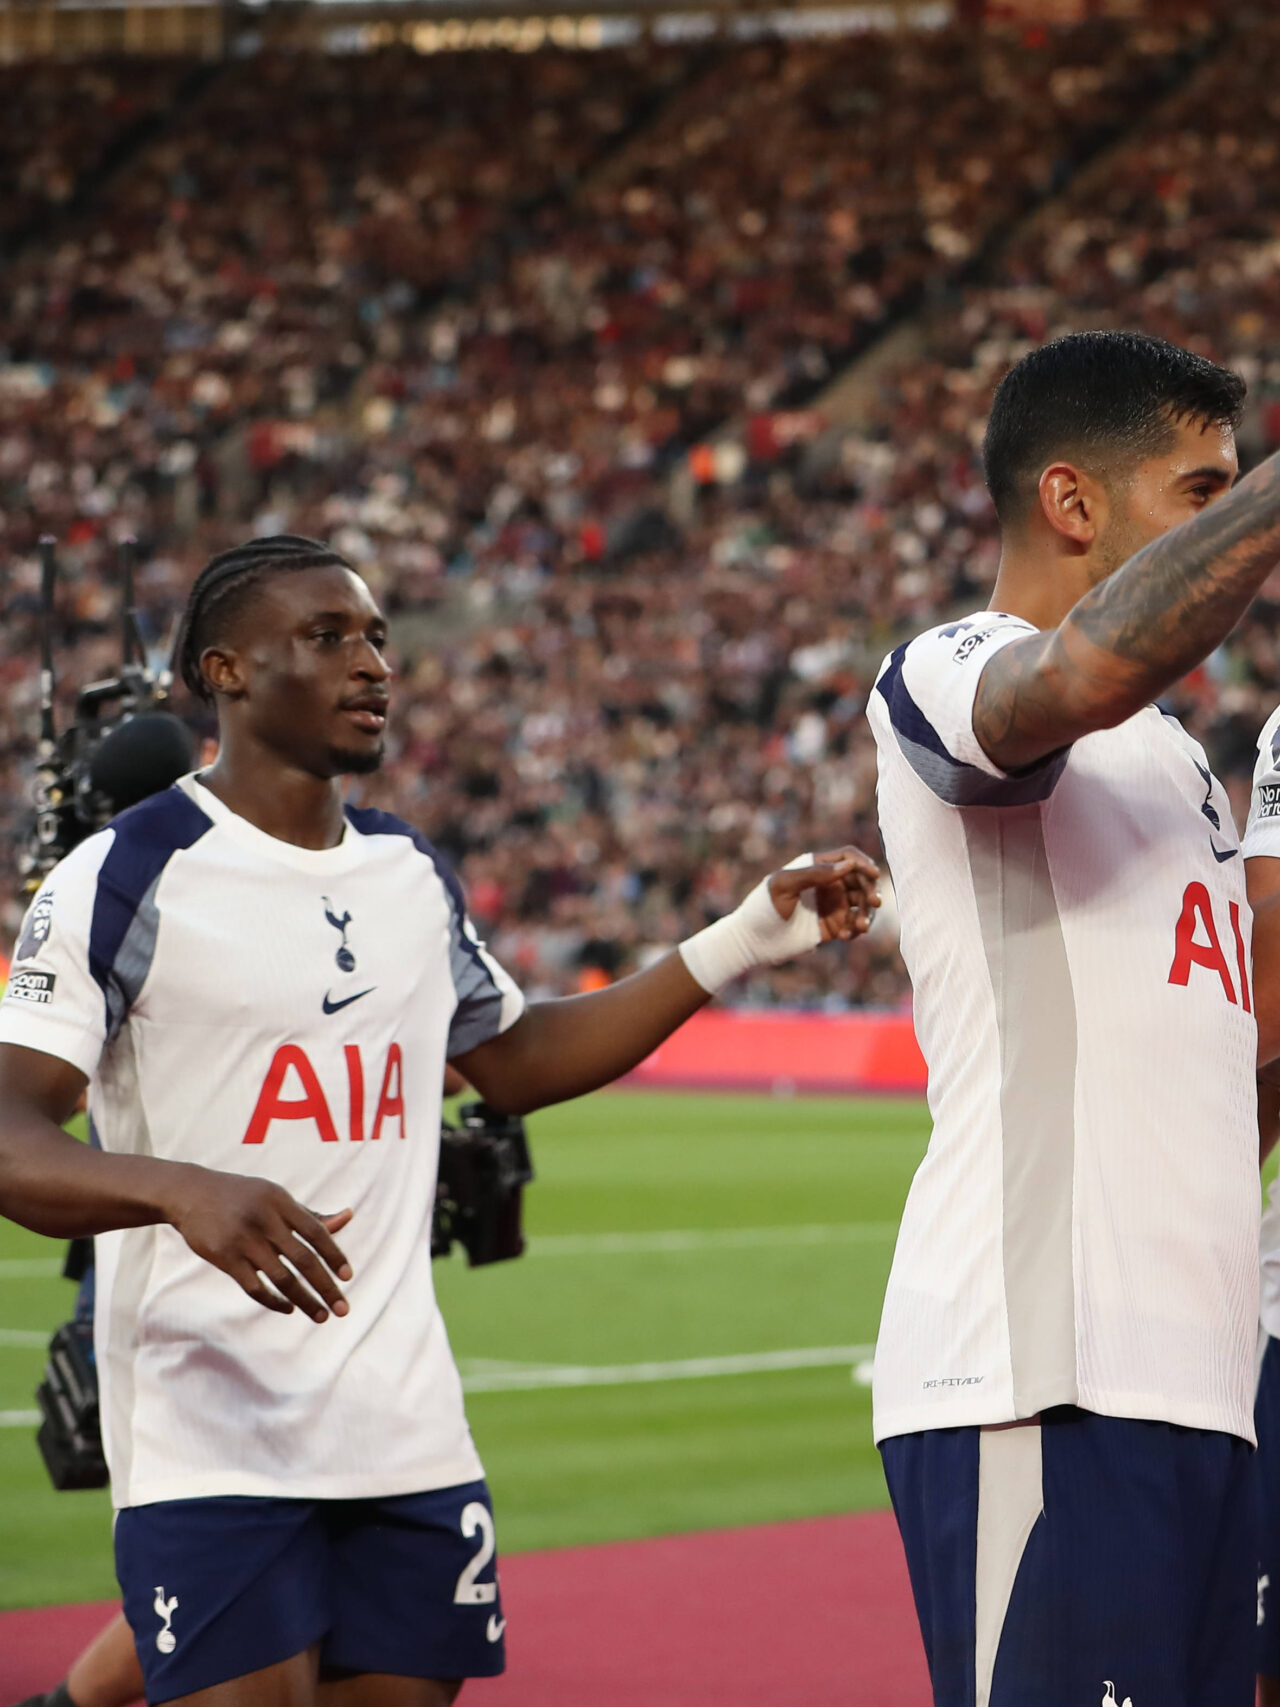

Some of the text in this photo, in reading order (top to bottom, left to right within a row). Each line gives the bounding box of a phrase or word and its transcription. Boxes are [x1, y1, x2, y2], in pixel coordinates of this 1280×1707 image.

[1260, 786, 1275, 803] No
[1167, 881, 1251, 1014] AI
[242, 1042, 406, 1144] AIA
[454, 1501, 500, 1604] 2
